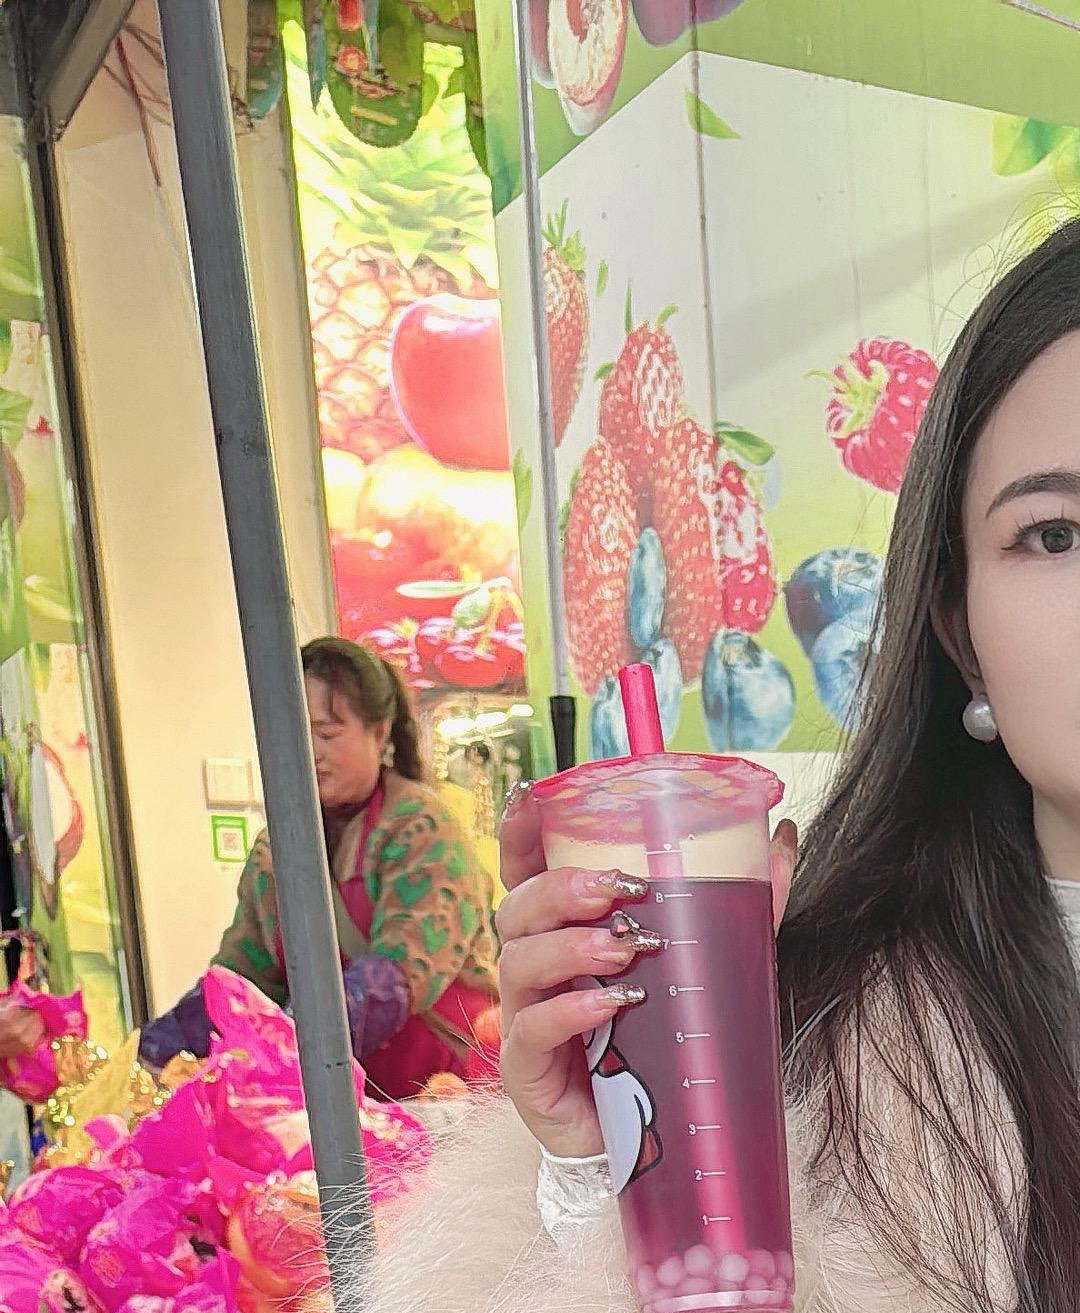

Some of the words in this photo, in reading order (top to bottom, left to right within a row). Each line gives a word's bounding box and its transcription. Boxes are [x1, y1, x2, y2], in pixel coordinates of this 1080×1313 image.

[655, 892, 664, 904] 8
[669, 985, 678, 997] 6
[676, 1031, 684, 1043] 5
[682, 1077, 690, 1089] 4
[688, 1123, 696, 1135] 3
[695, 1169, 703, 1180] 2
[701, 1214, 709, 1226] 1
